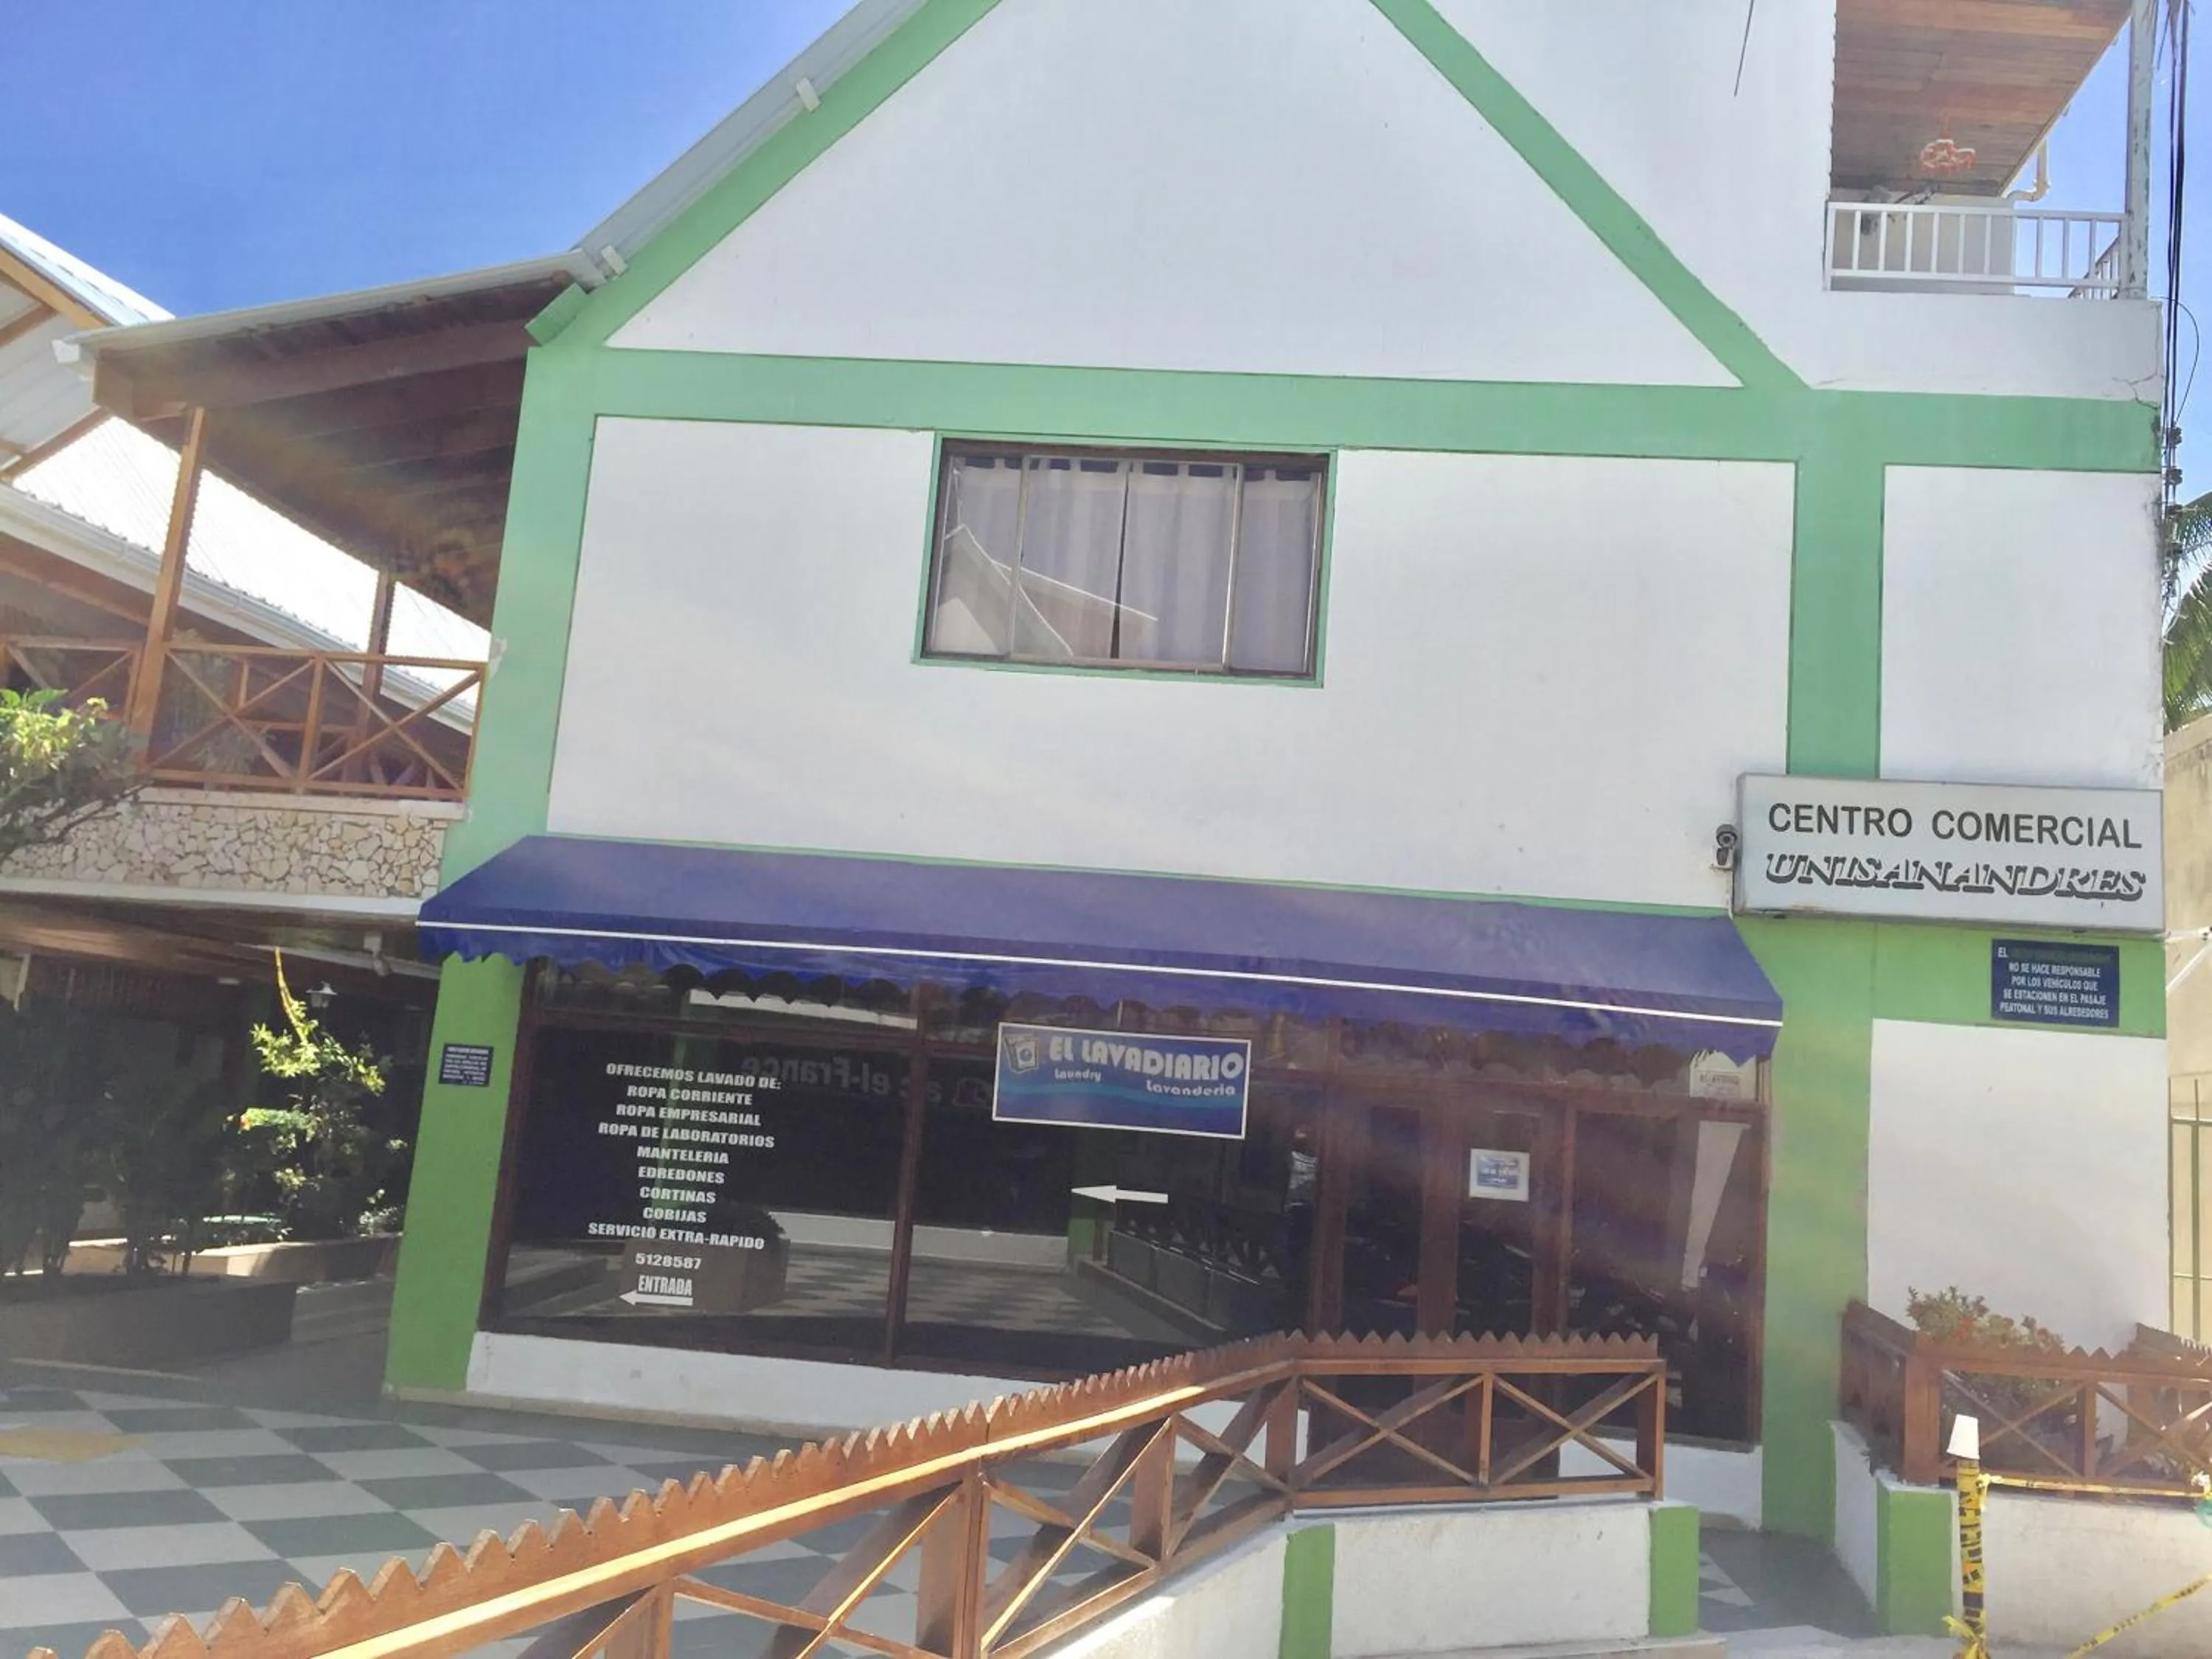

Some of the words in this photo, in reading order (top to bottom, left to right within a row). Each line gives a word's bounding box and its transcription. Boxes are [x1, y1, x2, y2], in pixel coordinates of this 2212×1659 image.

[1768, 803, 1913, 838] CENTRO
[1931, 810, 2143, 849] COMERCIAL
[1766, 852, 2146, 902] UNISANANDRES
[1997, 947, 2008, 958] EL
[2008, 962, 2019, 973] NO
[2021, 963, 2030, 973] SE
[2031, 964, 2050, 975] HACE
[2051, 965, 2101, 978] RESPONSABLE
[2011, 975, 2025, 986] POR
[2028, 976, 2041, 987] LOS
[2083, 981, 2098, 992] QUE
[2003, 989, 2012, 999] SE
[2014, 989, 2057, 1002] ESTACIONEN
[2059, 992, 2069, 1003] EN
[2070, 993, 2078, 1004] EL
[2080, 994, 2107, 1005] PASAJE
[2000, 1002, 2035, 1014] PEATONAL
[2037, 1004, 2042, 1015] Y
[2044, 1005, 2058, 1015] SUS
[2059, 1006, 2109, 1019] ALREDEDORES
[1048, 1035, 1074, 1062] EL
[1081, 1039, 1244, 1081] LAVADIARIO
[606, 1063, 694, 1082] OFRECEMOS
[698, 1071, 754, 1088] LAVADO
[758, 1077, 782, 1090] DE:
[627, 1085, 666, 1099] ROPA
[669, 1088, 753, 1106] CORRIENTE
[616, 1104, 655, 1119] ROPA
[659, 1107, 761, 1127] EMPRESARIAL
[598, 1121, 638, 1137] ROPA
[641, 1127, 659, 1139] DE
[663, 1127, 775, 1148] LABORATORIOS
[636, 1146, 729, 1164] MANTELERIA
[638, 1166, 725, 1184] EDREDONES
[639, 1186, 717, 1204] CORTINAS
[642, 1207, 707, 1223] COBIJAS
[588, 1222, 656, 1239] SERVICIO
[659, 1228, 765, 1250] EXTRA-RAPIDO
[636, 1253, 701, 1270] 5128587
[638, 1275, 692, 1296] ENTRADA
